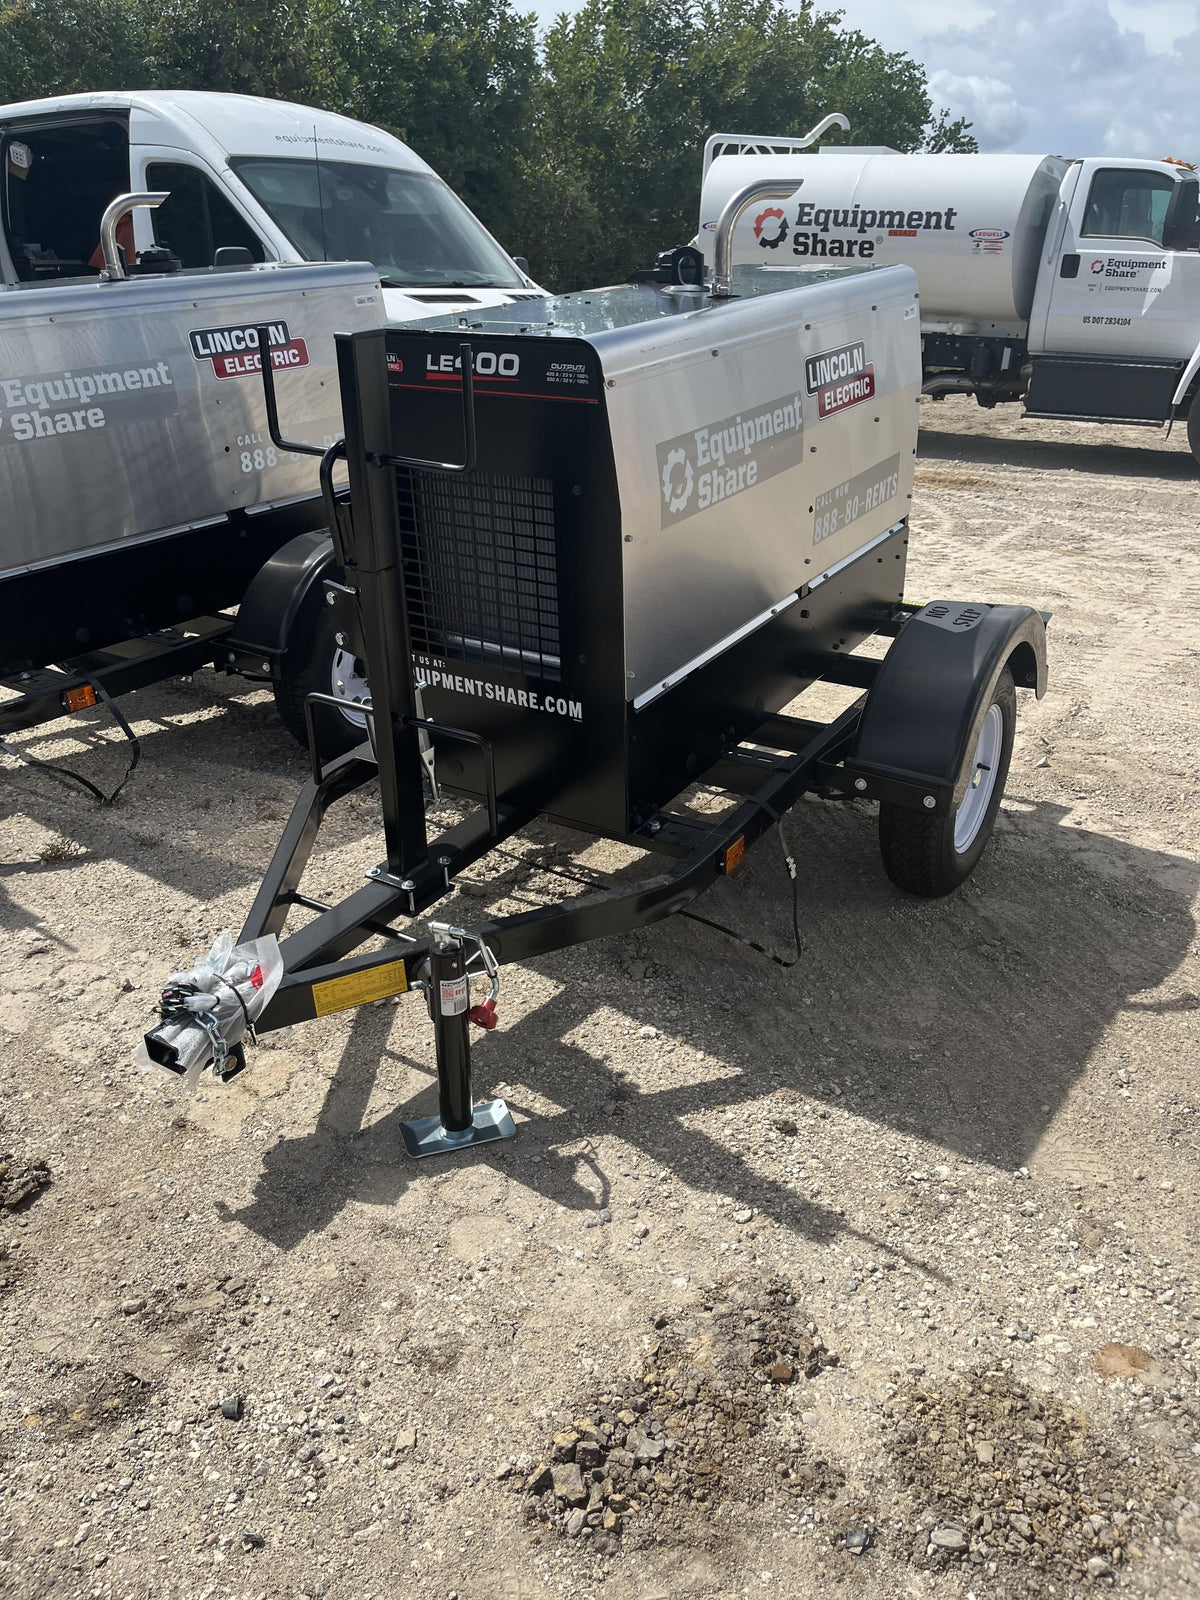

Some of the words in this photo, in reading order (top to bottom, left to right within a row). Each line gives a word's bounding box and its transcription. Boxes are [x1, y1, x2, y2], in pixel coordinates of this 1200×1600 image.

[795, 203, 957, 234] Equipment
[1105, 268, 1137, 278] Share
[1107, 259, 1167, 269] Equipment
[1083, 316, 1091, 324] US
[1092, 317, 1104, 325] DOT
[195, 325, 286, 355] LINCON
[224, 349, 300, 373] ELECRIC
[808, 347, 863, 389] LINCOLN
[1, 362, 172, 409] Equipment
[825, 377, 870, 411] ELECTRIC
[11, 407, 105, 440] Share
[695, 396, 802, 467] Equipment
[237, 432, 263, 446] CALL
[698, 460, 757, 509] Share
[816, 493, 833, 510] CALL
[835, 484, 850, 498] NOW
[814, 472, 898, 542] 888-80-RENTS
[925, 606, 950, 619] NO
[953, 608, 982, 627] STEP
[419, 656, 430, 665] US
[433, 659, 446, 668] AT:
[412, 667, 583, 719] UIPMENTSHARE.COM
